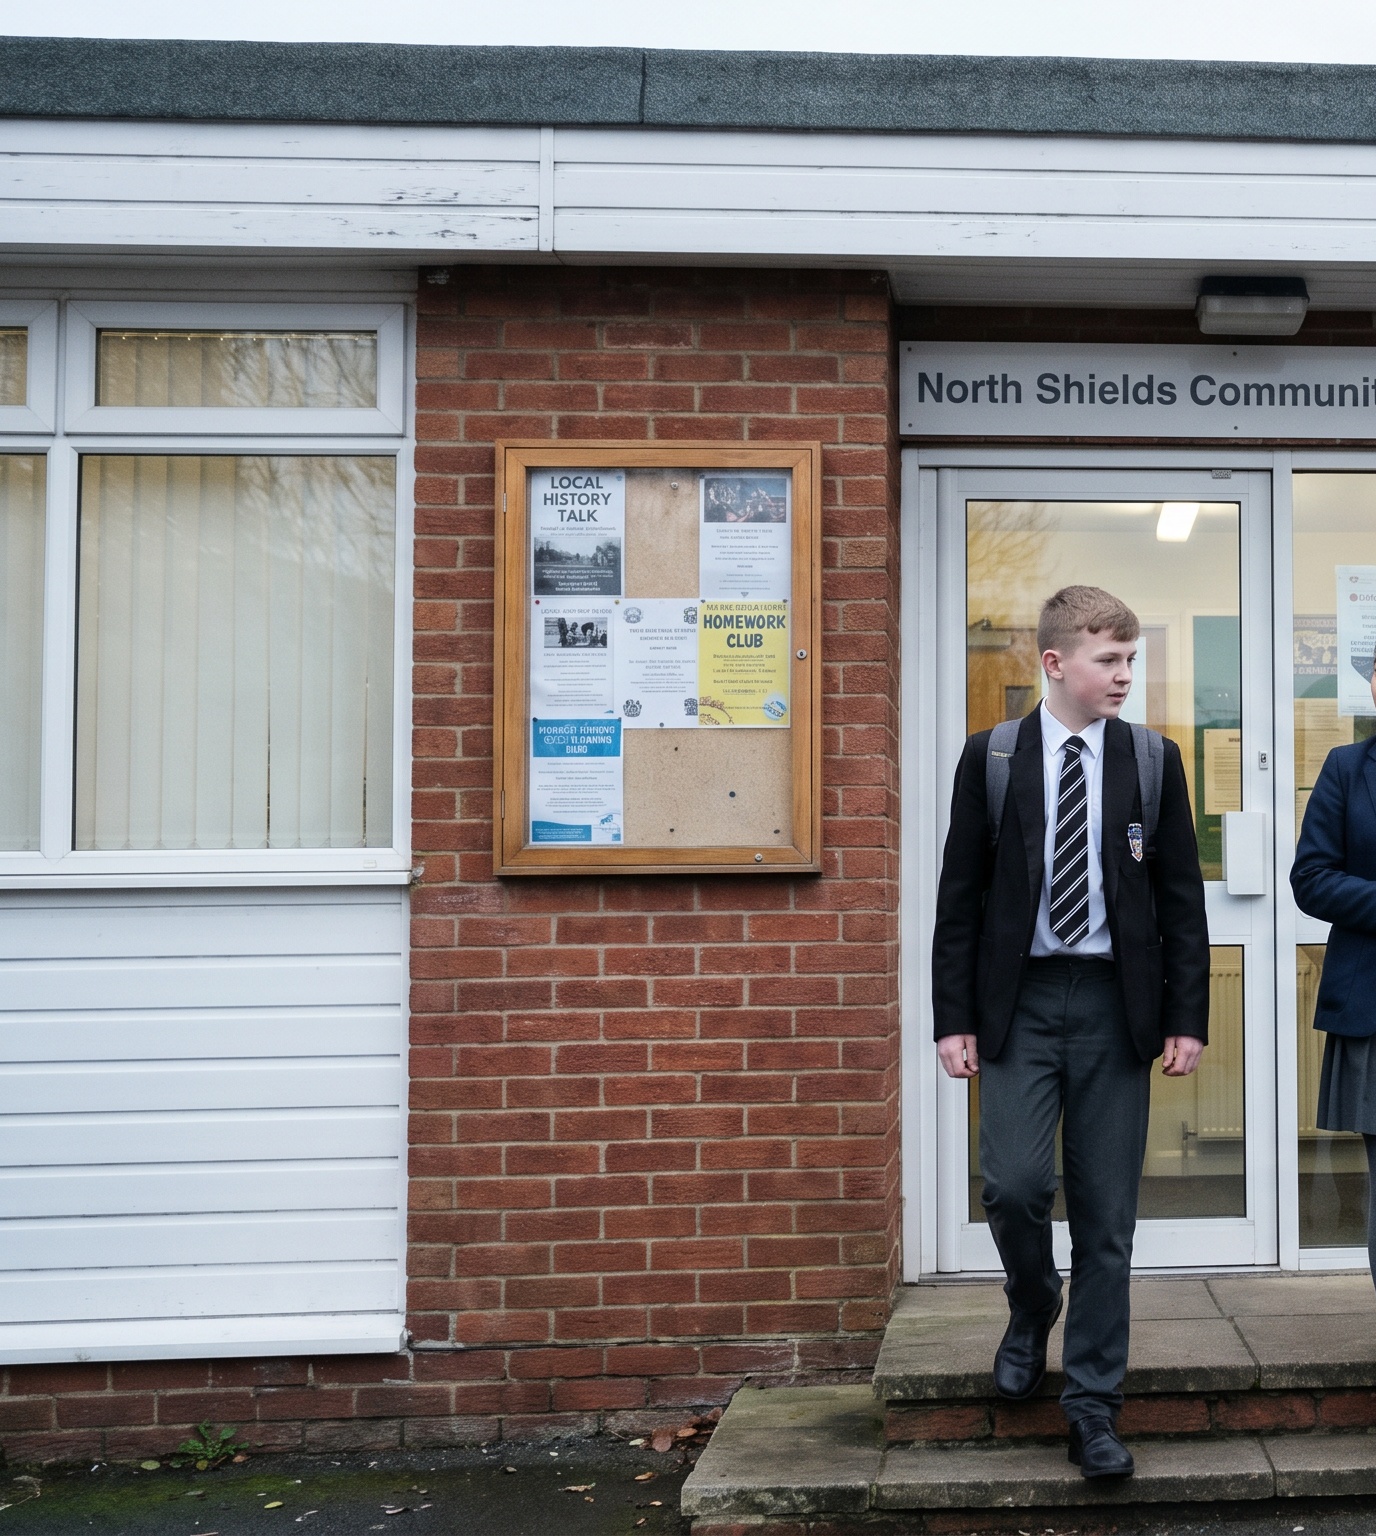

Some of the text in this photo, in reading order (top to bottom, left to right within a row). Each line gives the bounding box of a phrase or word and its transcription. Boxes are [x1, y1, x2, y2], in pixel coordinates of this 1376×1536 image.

[917, 372, 1022, 404] North
[1036, 373, 1177, 405] Shields
[551, 476, 604, 489] LOCAL
[543, 493, 612, 506] HISTORY
[557, 509, 598, 522] TALK
[703, 614, 786, 629] HOMEWORK
[726, 633, 764, 648] CLUB
